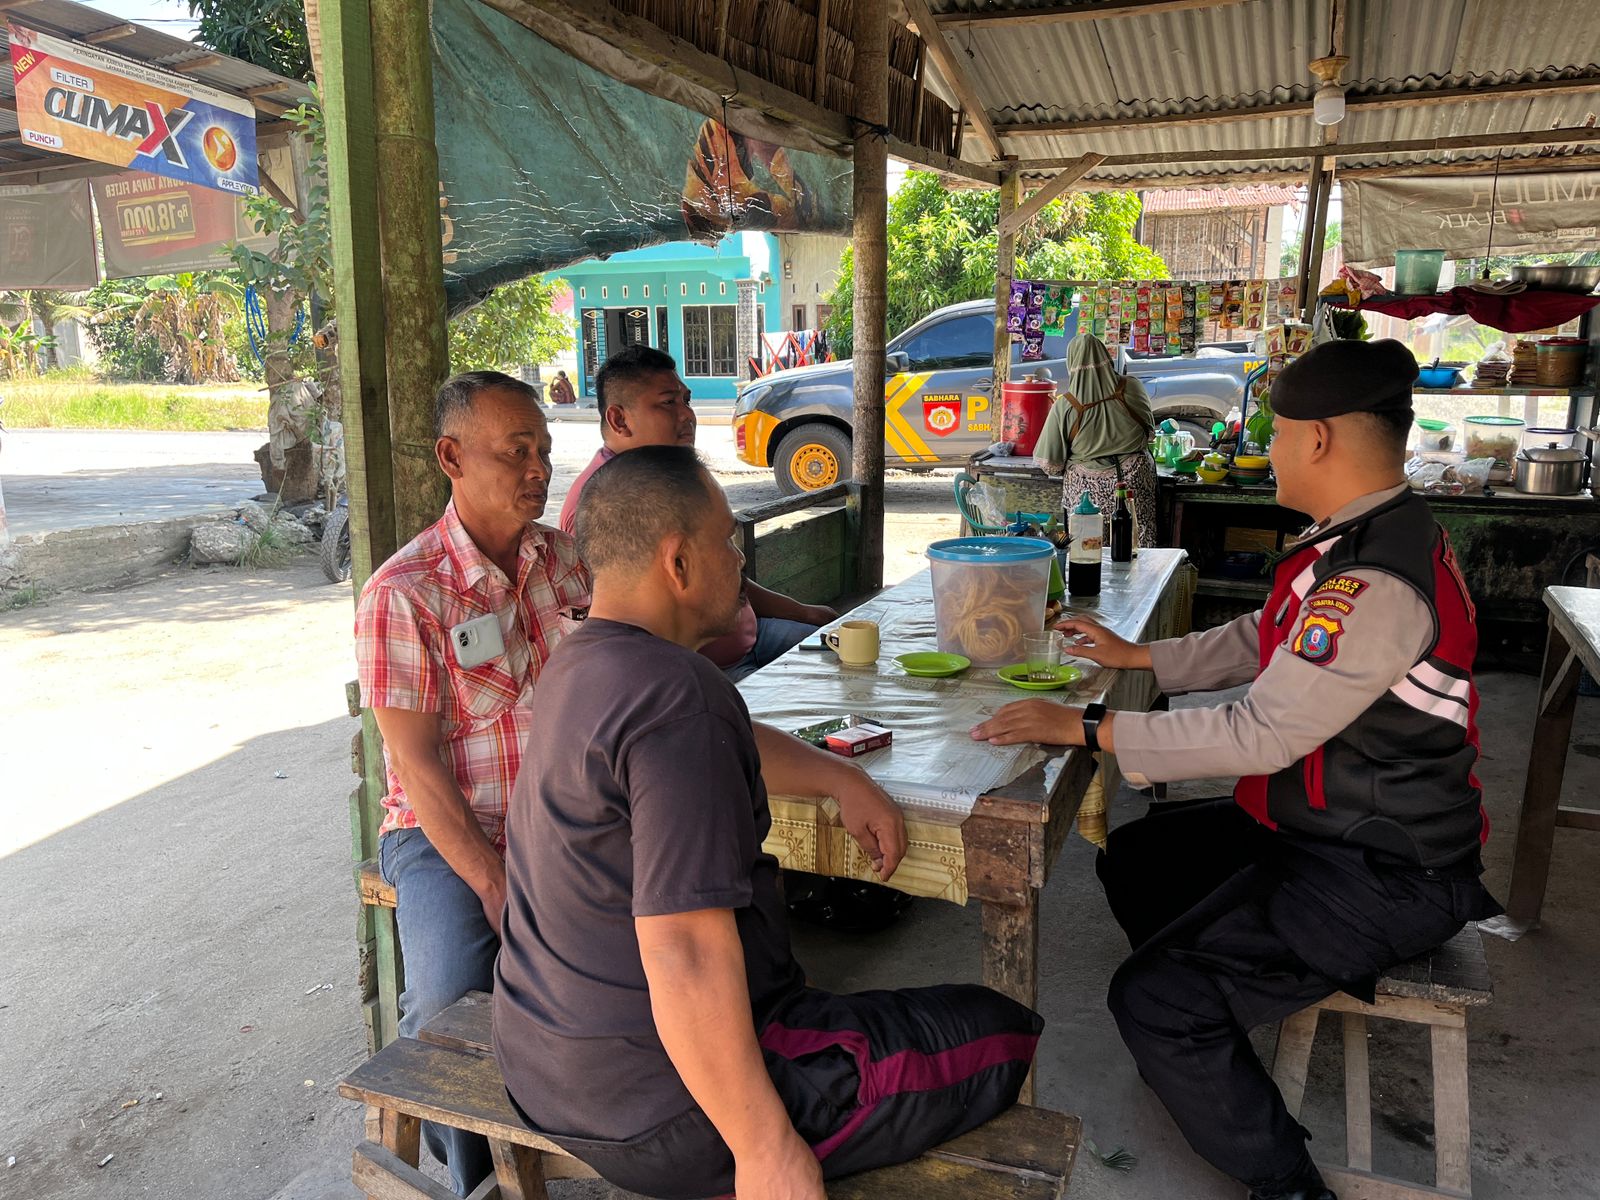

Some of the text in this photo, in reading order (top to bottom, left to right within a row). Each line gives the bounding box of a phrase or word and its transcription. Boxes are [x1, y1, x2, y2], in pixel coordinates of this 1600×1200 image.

[13, 51, 36, 76] NEW
[55, 71, 89, 89] FILTER
[43, 86, 195, 169] CLIMAX
[29, 132, 56, 146] PUNCH
[924, 394, 960, 402] SABHARA
[967, 396, 992, 421] P
